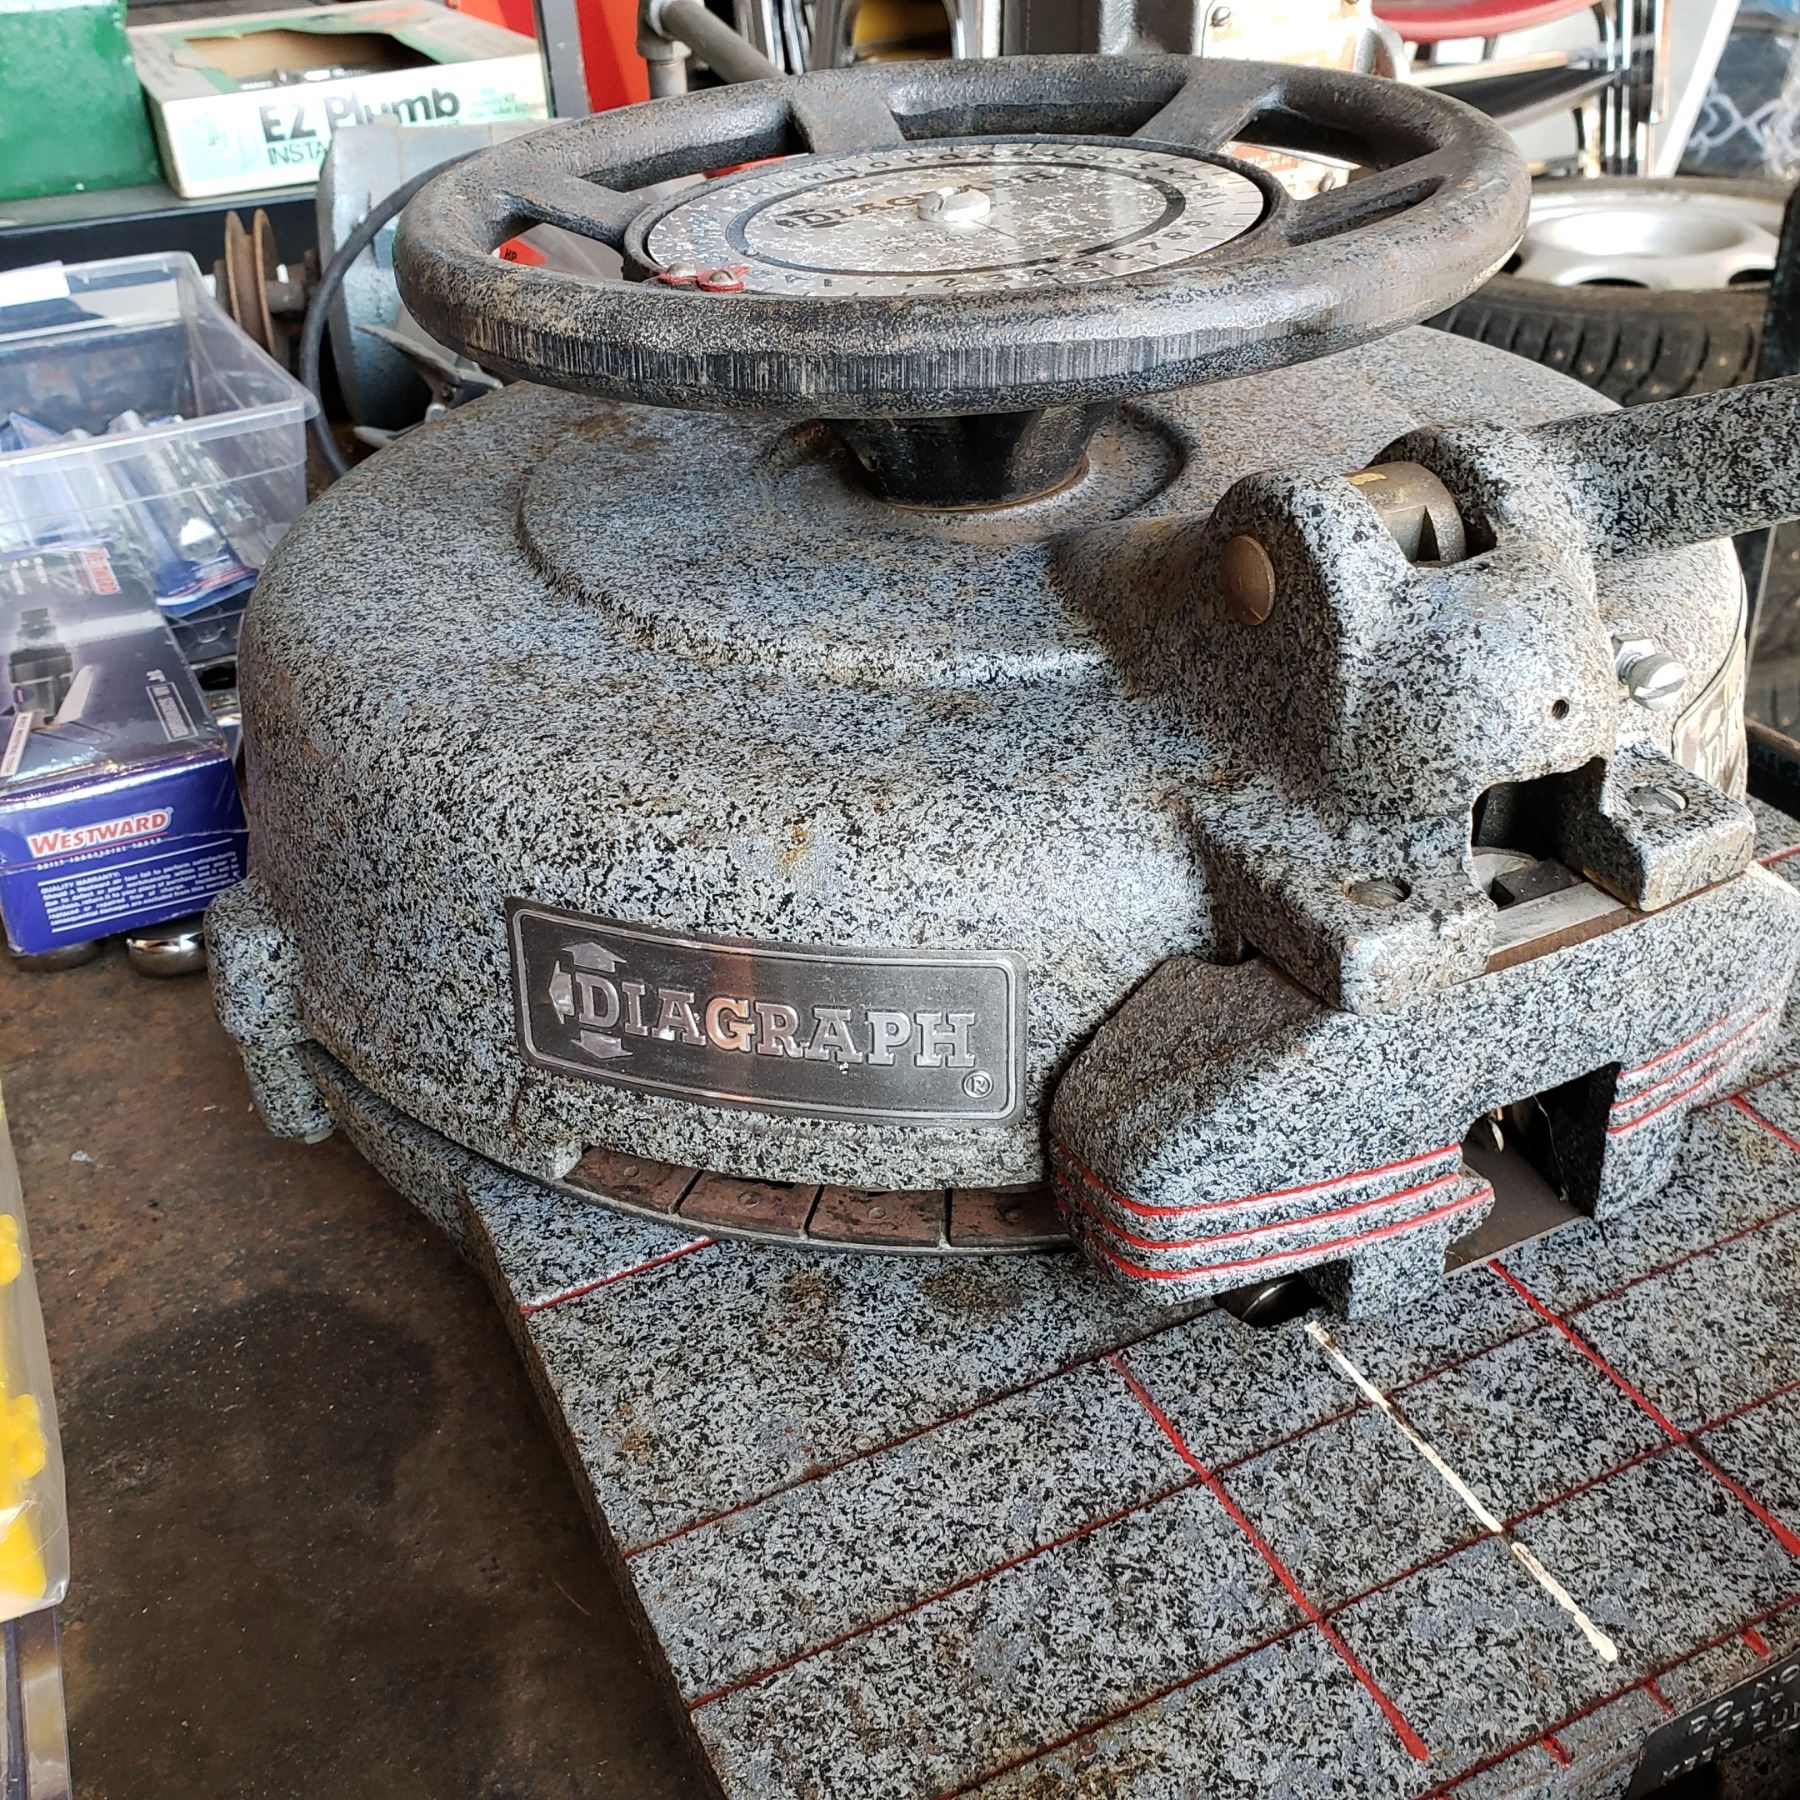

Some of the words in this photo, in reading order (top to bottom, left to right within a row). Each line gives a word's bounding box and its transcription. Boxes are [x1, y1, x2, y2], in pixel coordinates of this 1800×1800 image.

[259, 104, 317, 143] EZ
[30, 813, 168, 855] WESTWARD
[576, 971, 978, 1069] DIAGRAPH
